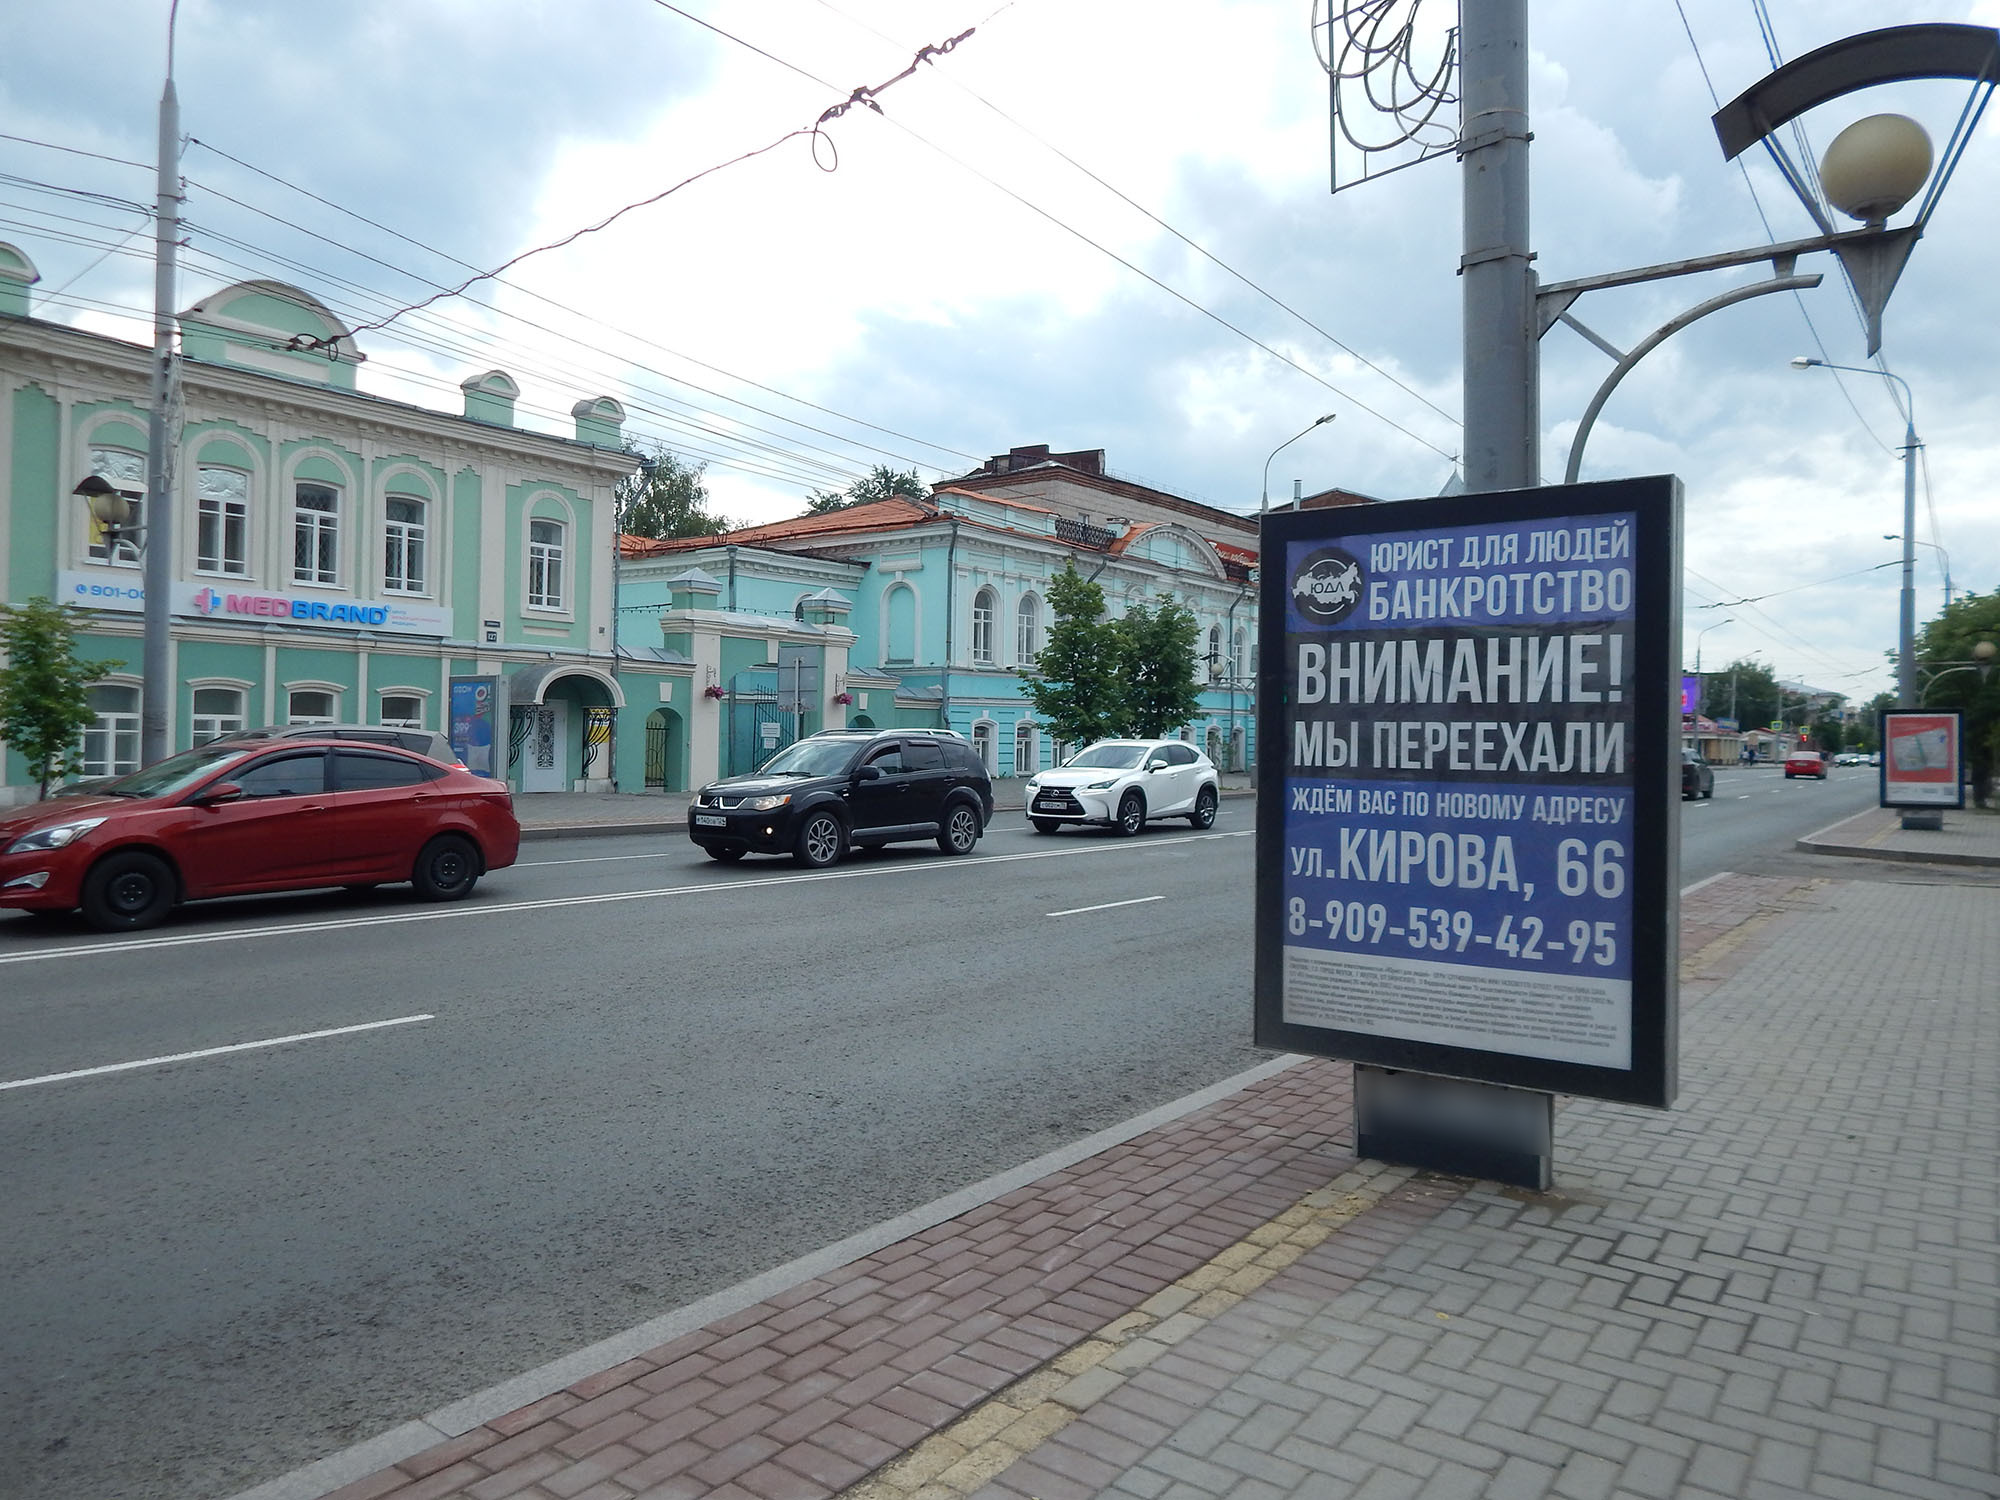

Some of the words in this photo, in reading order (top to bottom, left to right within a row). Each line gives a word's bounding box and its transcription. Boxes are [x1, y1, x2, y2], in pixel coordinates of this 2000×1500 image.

[1370, 537, 1455, 573] ЮРИСТ
[1459, 533, 1519, 569] ДЛЯ
[1525, 519, 1631, 563] ЛЮДЕЙ
[227, 593, 388, 625] MEDBRAND
[1369, 567, 1632, 621] БАНКРОТСТВО
[1297, 634, 1624, 704] ВНИМАНИЕ!
[1293, 720, 1358, 768] МЫ
[1373, 721, 1625, 774] ПЕРЕЕХАЛИ
[1292, 784, 1353, 816] ЖДЁМ
[1358, 789, 1397, 816] ВАС
[1402, 791, 1430, 818] ПО
[1435, 792, 1526, 821] НОВОМУ
[1533, 796, 1626, 827] АДРЕСУ
[1557, 838, 1626, 899] 66
[1288, 896, 1617, 967] 8-909-539-42-95
